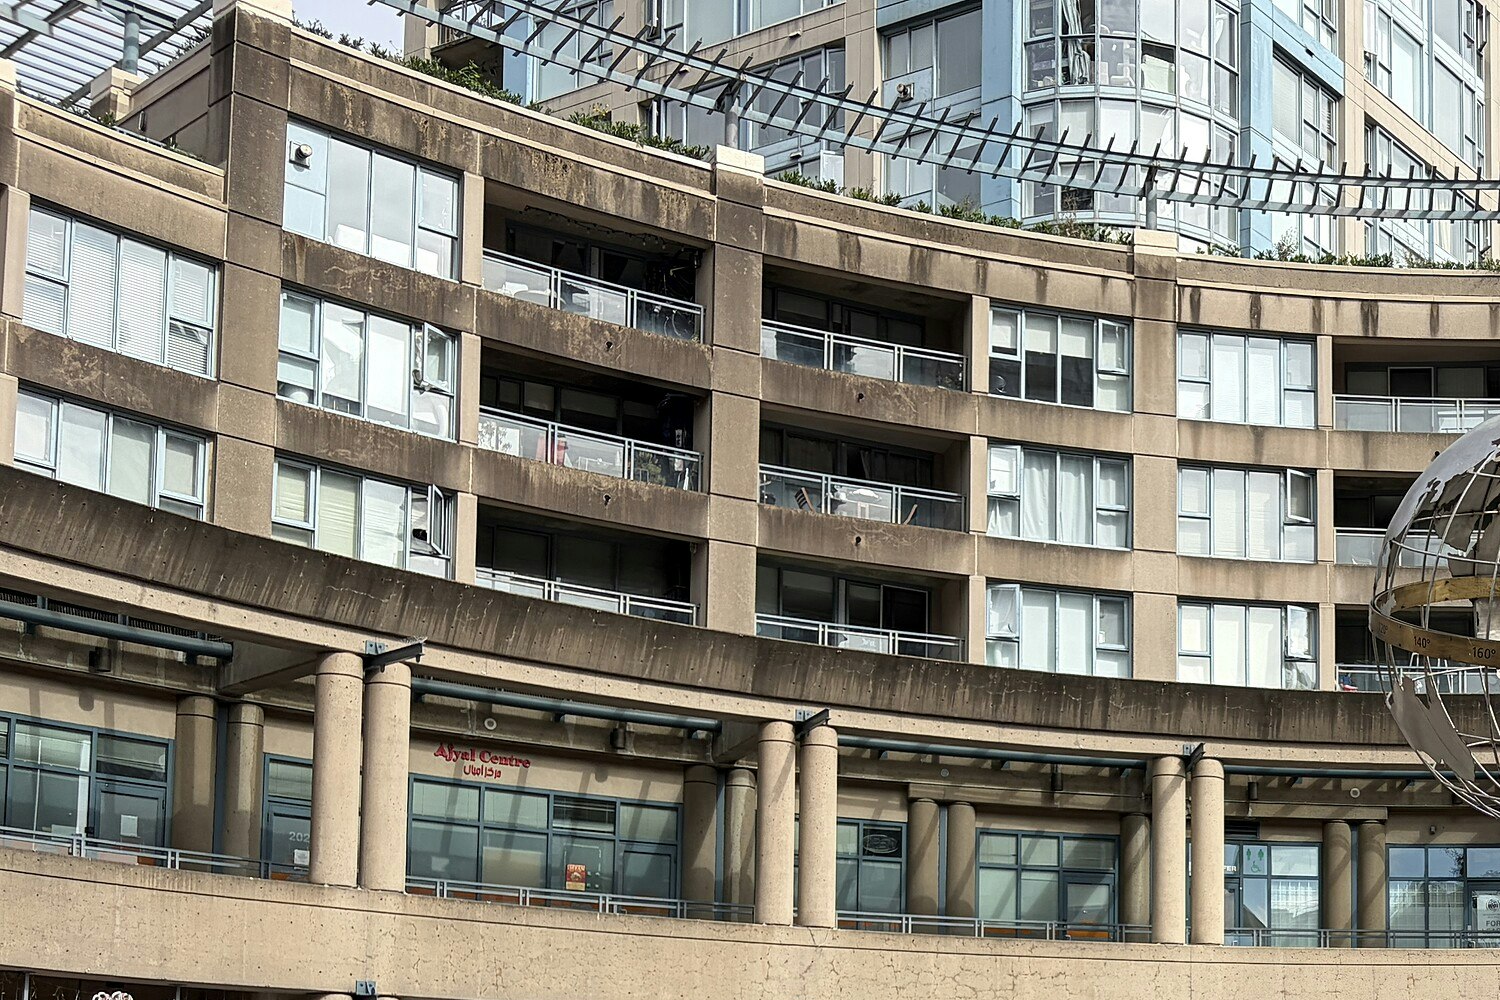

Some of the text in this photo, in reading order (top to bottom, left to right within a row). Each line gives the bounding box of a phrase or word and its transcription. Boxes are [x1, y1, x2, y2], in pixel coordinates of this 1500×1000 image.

[1413, 635, 1431, 649] 140°
[1472, 647, 1496, 660] 160°
[434, 743, 531, 769] Ajyal Centre
[289, 831, 310, 843] 202
